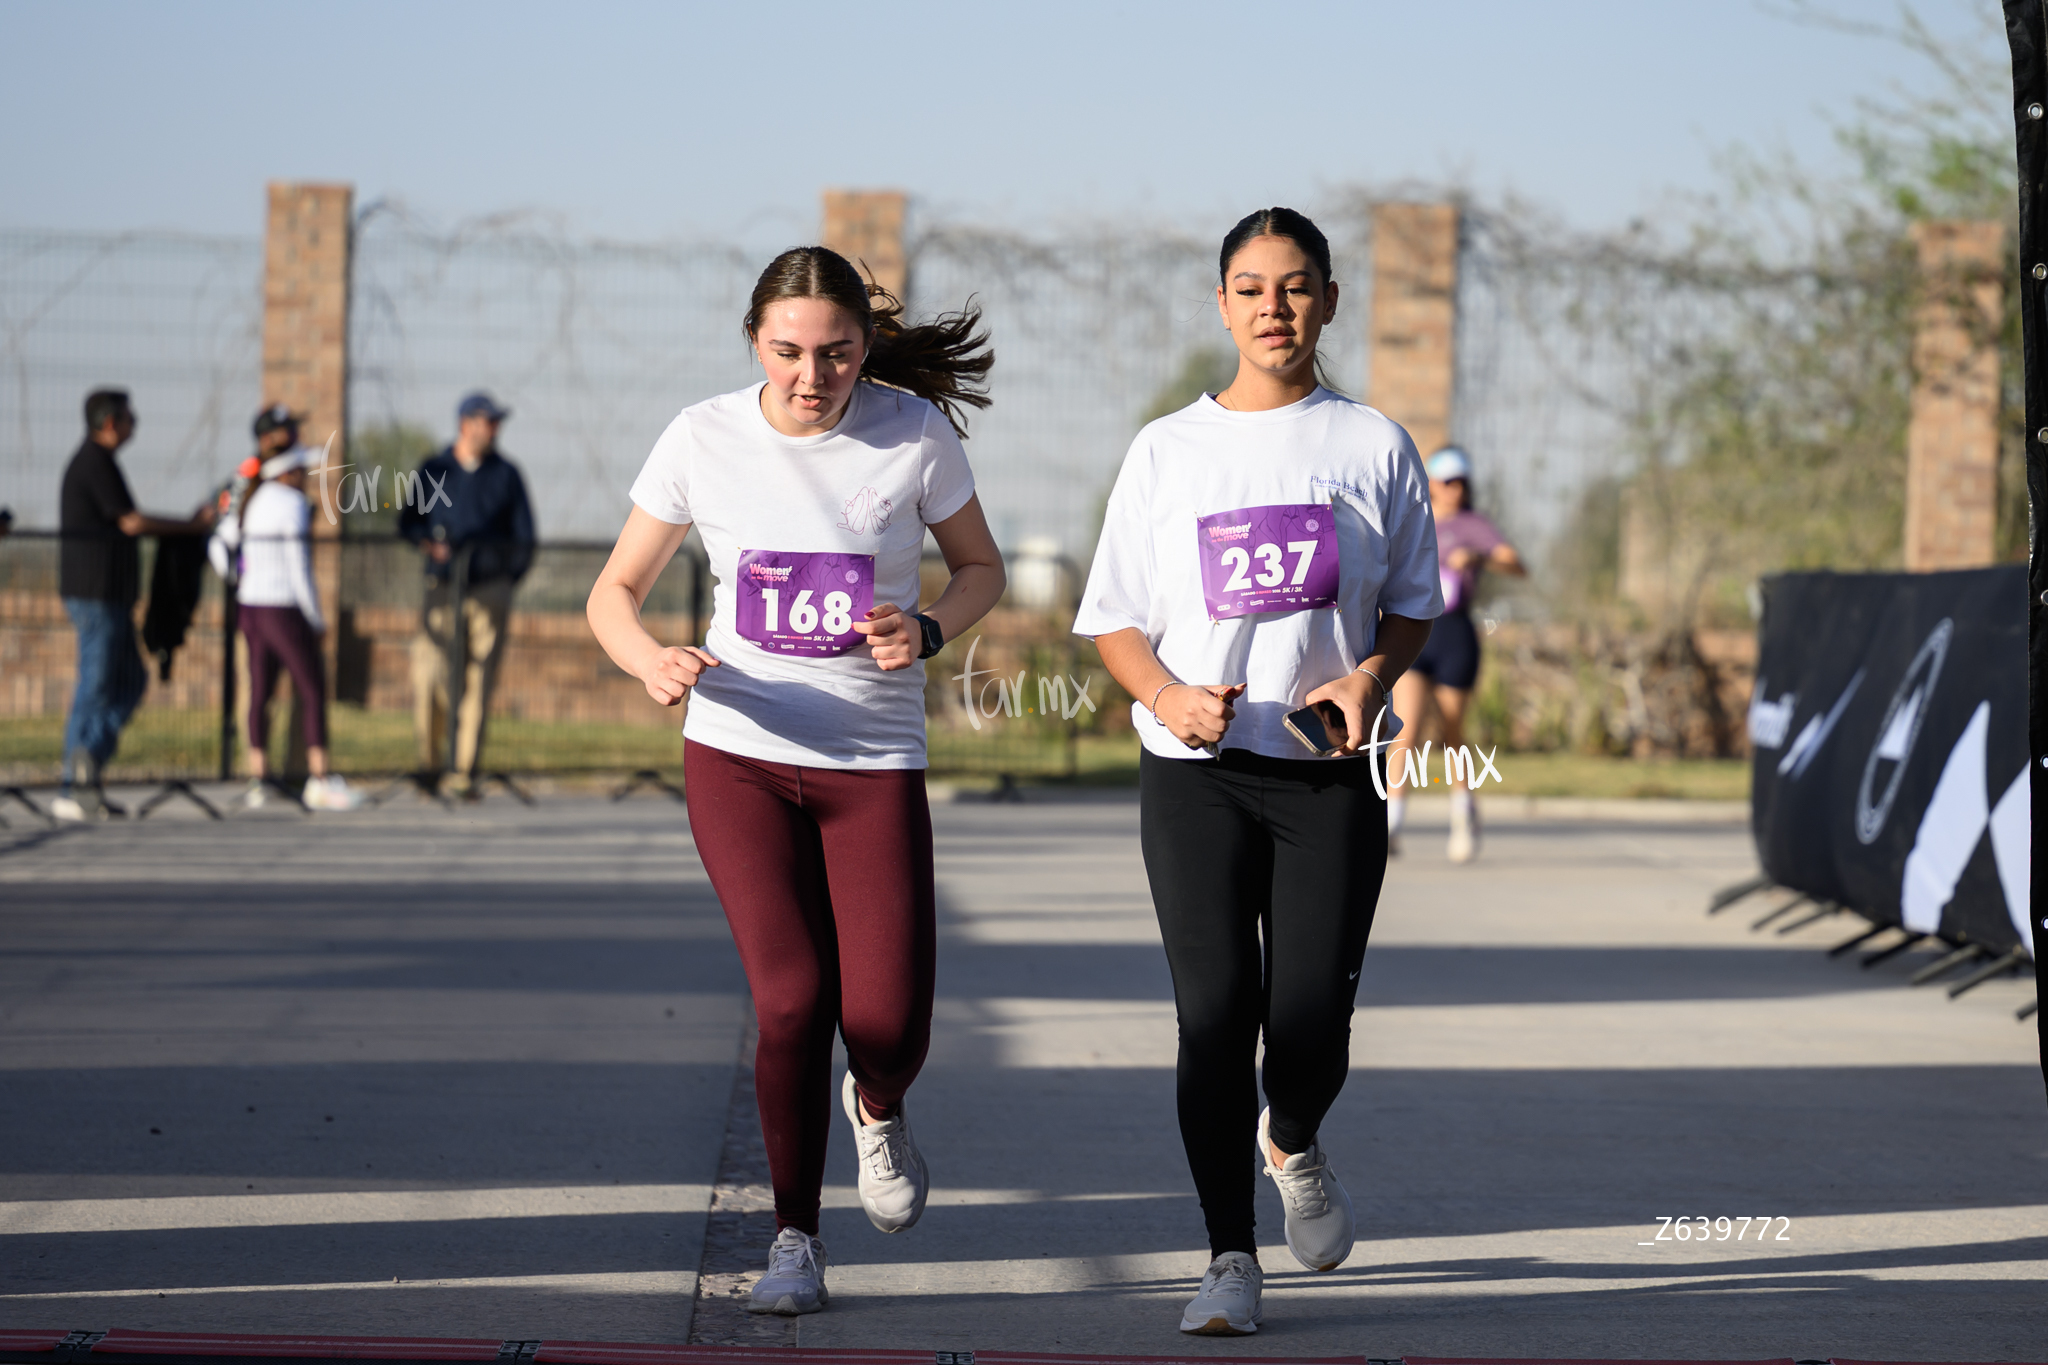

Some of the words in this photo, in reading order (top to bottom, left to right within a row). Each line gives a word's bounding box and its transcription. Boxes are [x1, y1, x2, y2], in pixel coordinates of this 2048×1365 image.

[1310, 475, 1341, 487] Florida
[1223, 532, 1249, 542] move
[1221, 540, 1318, 592] 237
[761, 588, 852, 635] 168
